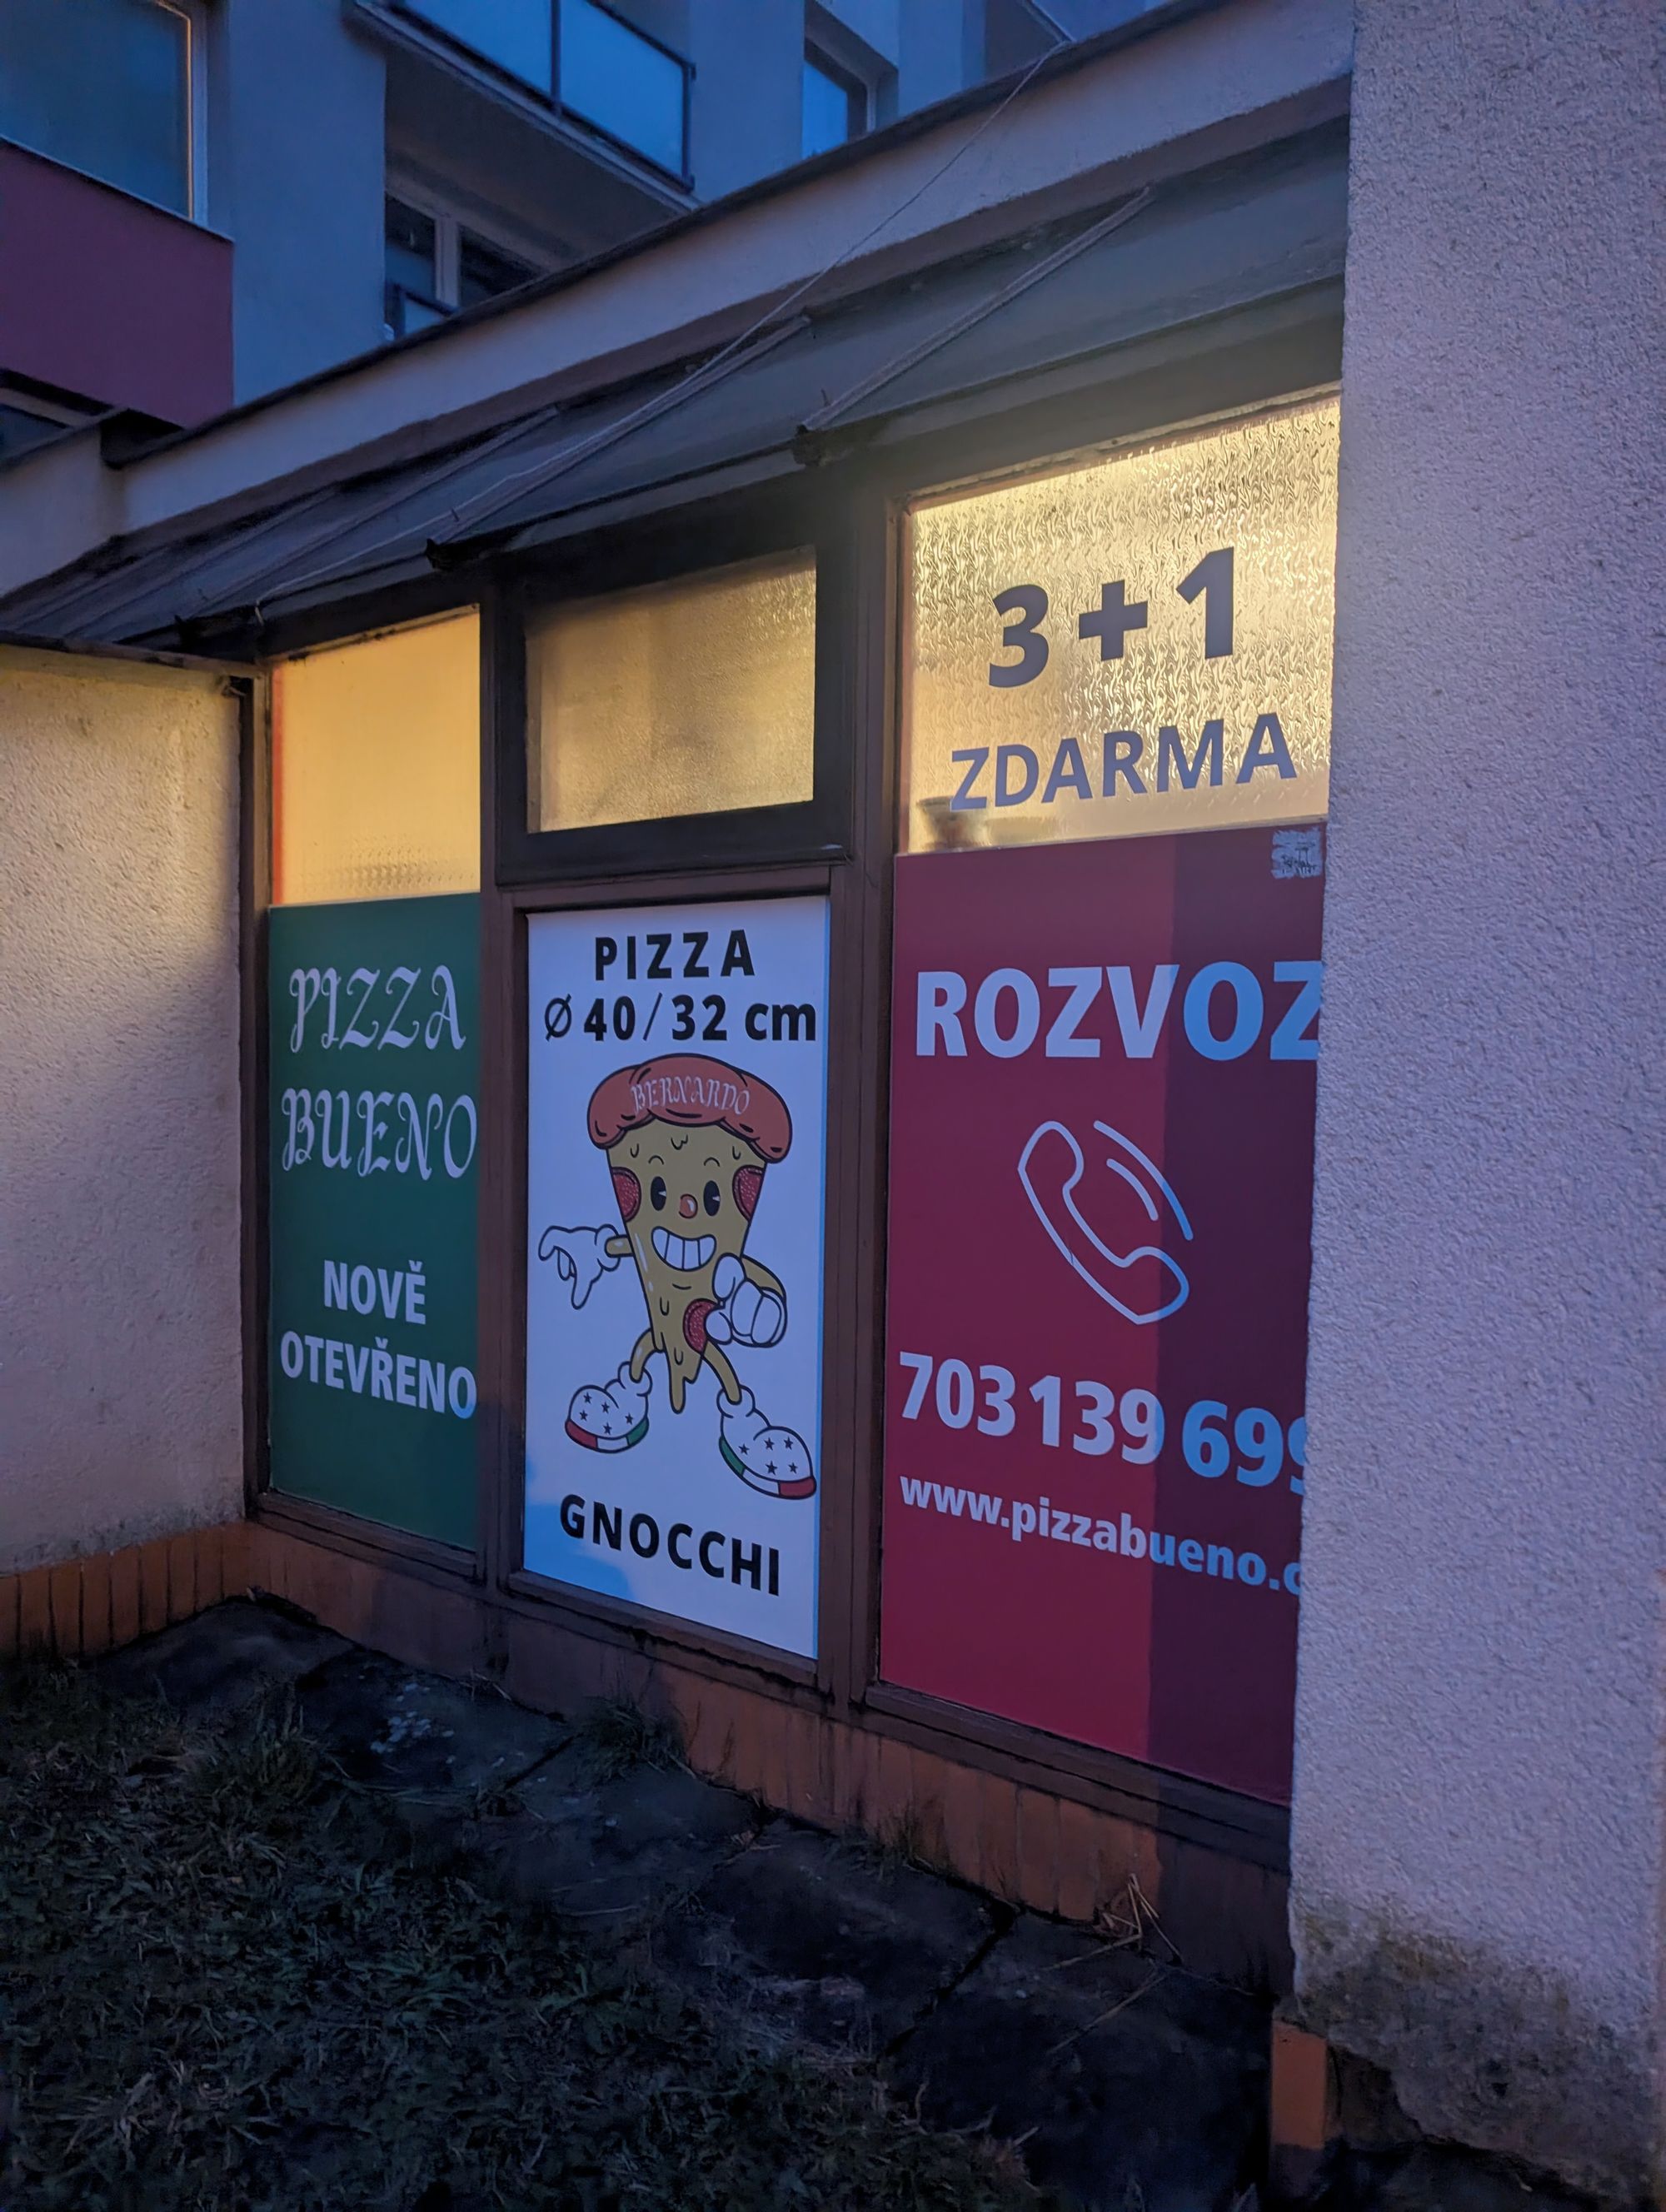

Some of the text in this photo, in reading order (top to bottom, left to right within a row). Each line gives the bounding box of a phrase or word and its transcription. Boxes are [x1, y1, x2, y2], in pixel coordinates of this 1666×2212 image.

[950, 712, 1298, 812] ZDARMA
[595, 929, 755, 981] PIZZA
[289, 964, 466, 1053] PIZZA
[745, 1003, 816, 1042] cm
[915, 960, 1323, 1061] ROZVOZ
[281, 1087, 477, 1181] BUENO
[630, 1075, 751, 1116] BERNARDO
[323, 1259, 426, 1325] NOVĚ
[280, 1330, 477, 1419] OTEVŘENO
[899, 1351, 1016, 1437] 703
[1028, 1374, 1165, 1465] 139
[560, 1494, 780, 1597] GNOCCHI
